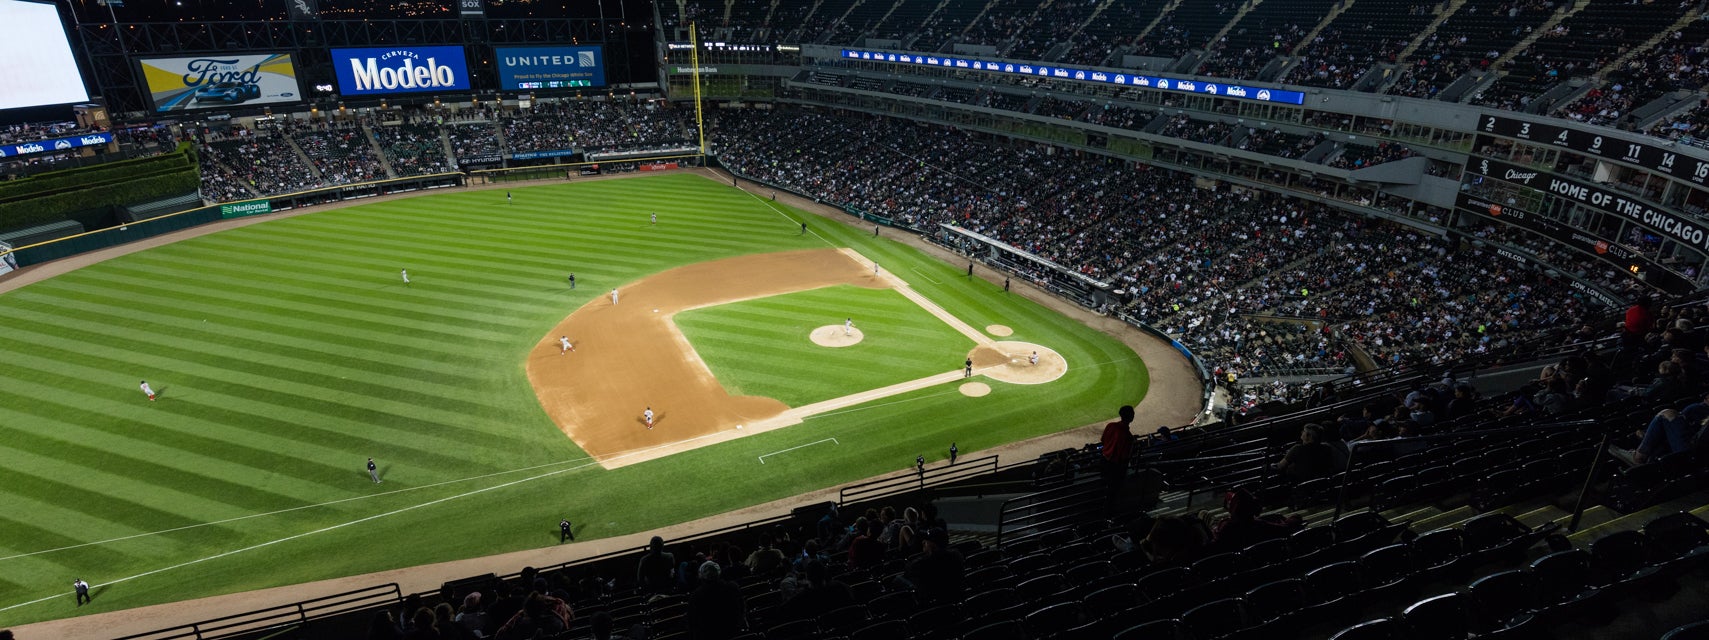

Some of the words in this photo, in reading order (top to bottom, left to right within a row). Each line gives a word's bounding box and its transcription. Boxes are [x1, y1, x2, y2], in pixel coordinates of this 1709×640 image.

[381, 50, 419, 60] CERVEZA
[505, 55, 575, 67] UNITED
[182, 59, 262, 87] Ford
[349, 57, 455, 91] Modelo
[1177, 81, 1195, 91] Modelo
[1227, 86, 1247, 97] Modelo
[1485, 117, 1496, 128] 2
[1520, 123, 1531, 134] 3
[1558, 129, 1569, 142] 4
[16, 144, 44, 154] Modelo
[81, 136, 106, 146] Modelo
[1592, 136, 1603, 149] 9
[1627, 144, 1642, 158] 11
[471, 156, 501, 164] HYUNDAI
[1661, 152, 1676, 168] 14
[1694, 161, 1709, 178] 16
[233, 202, 269, 213] National
[1505, 169, 1538, 184] Chicago
[1550, 179, 1587, 201] HOME
[1591, 191, 1611, 207] OF
[1616, 198, 1641, 219] THE
[1643, 209, 1703, 244] CHICAGO
[1502, 207, 1525, 220] CLUB
[1497, 248, 1527, 264] RATE.COM
[1608, 245, 1628, 260] CLUB
[1586, 287, 1600, 299] LOW
